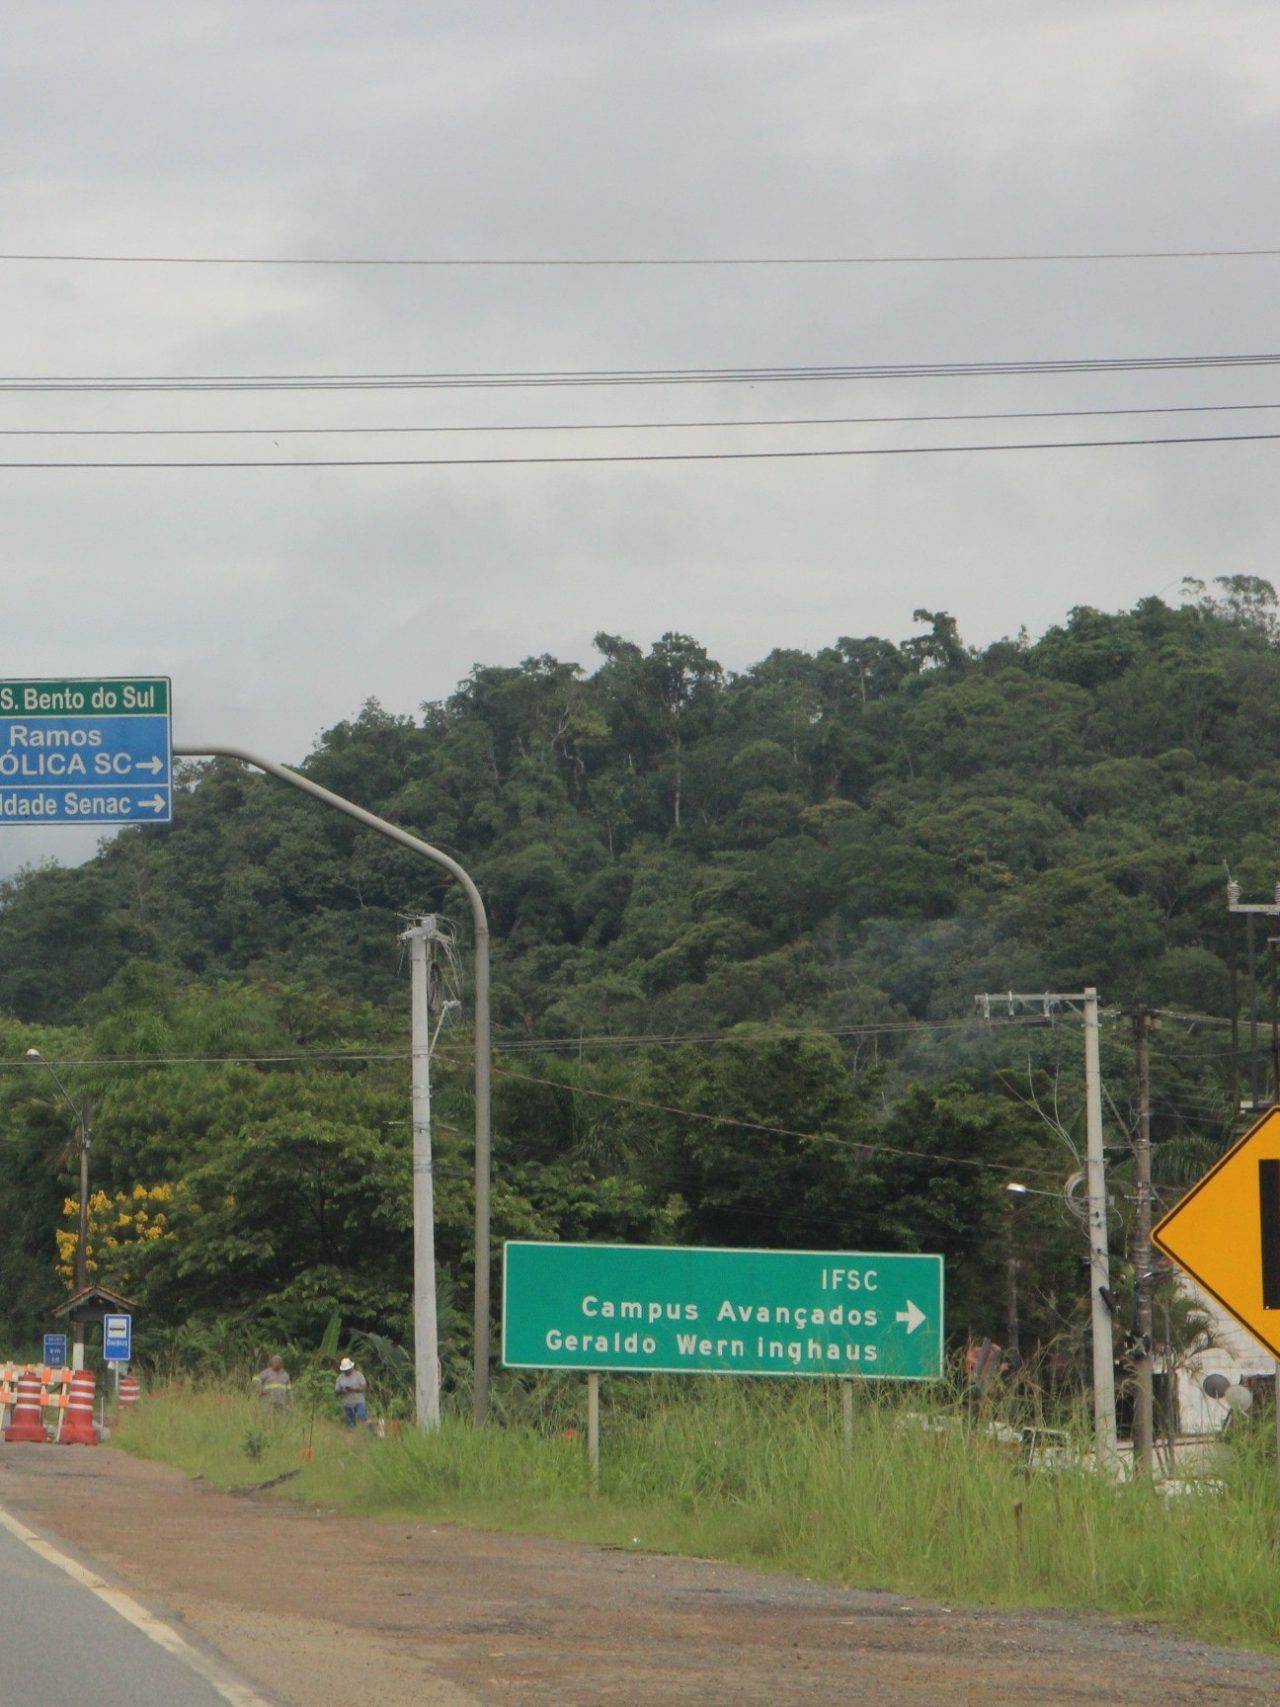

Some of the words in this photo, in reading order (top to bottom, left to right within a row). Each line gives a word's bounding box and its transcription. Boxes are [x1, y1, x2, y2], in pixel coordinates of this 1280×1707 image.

[23, 687, 85, 710] Bento
[91, 686, 117, 708] do
[123, 685, 155, 708] Sul
[10, 724, 102, 747] Ramos
[94, 752, 132, 775] SC
[64, 792, 131, 815] Senac
[821, 1268, 878, 1291] IFSC
[581, 1295, 699, 1324] Campus
[716, 1299, 878, 1330] Avançados
[545, 1329, 657, 1354] Geraldo
